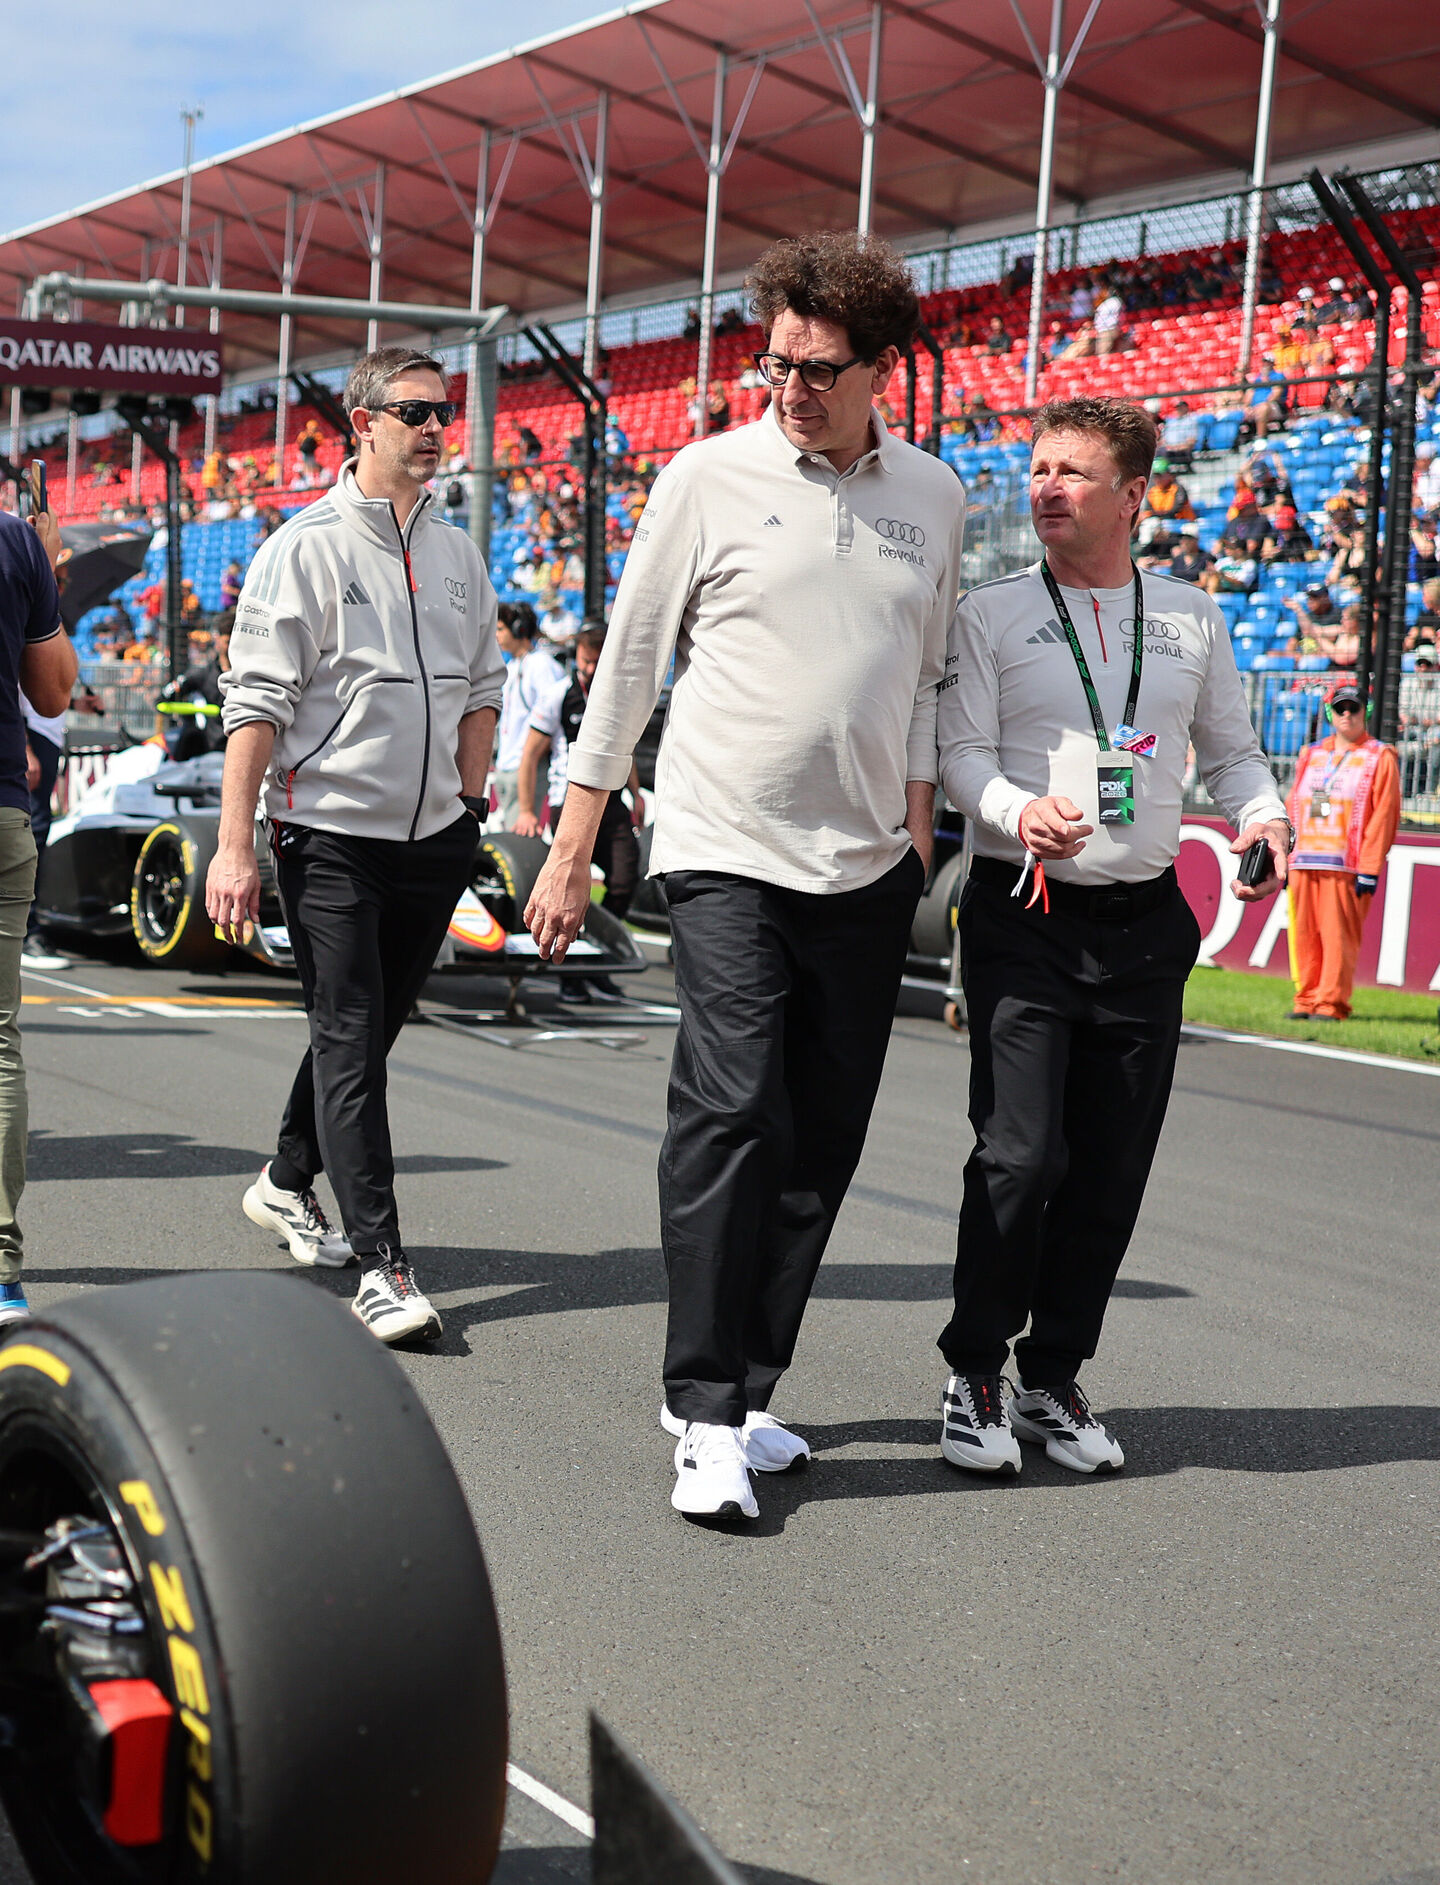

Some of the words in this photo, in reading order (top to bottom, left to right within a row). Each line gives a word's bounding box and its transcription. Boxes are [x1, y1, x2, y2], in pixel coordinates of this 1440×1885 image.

[98, 343, 221, 378] AIRWAYS
[878, 544, 927, 569] Revolut
[1122, 640, 1184, 660] Rvolut
[1099, 781, 1127, 791] PDK
[118, 1480, 166, 1536] P
[148, 1560, 212, 1862] ZERO
